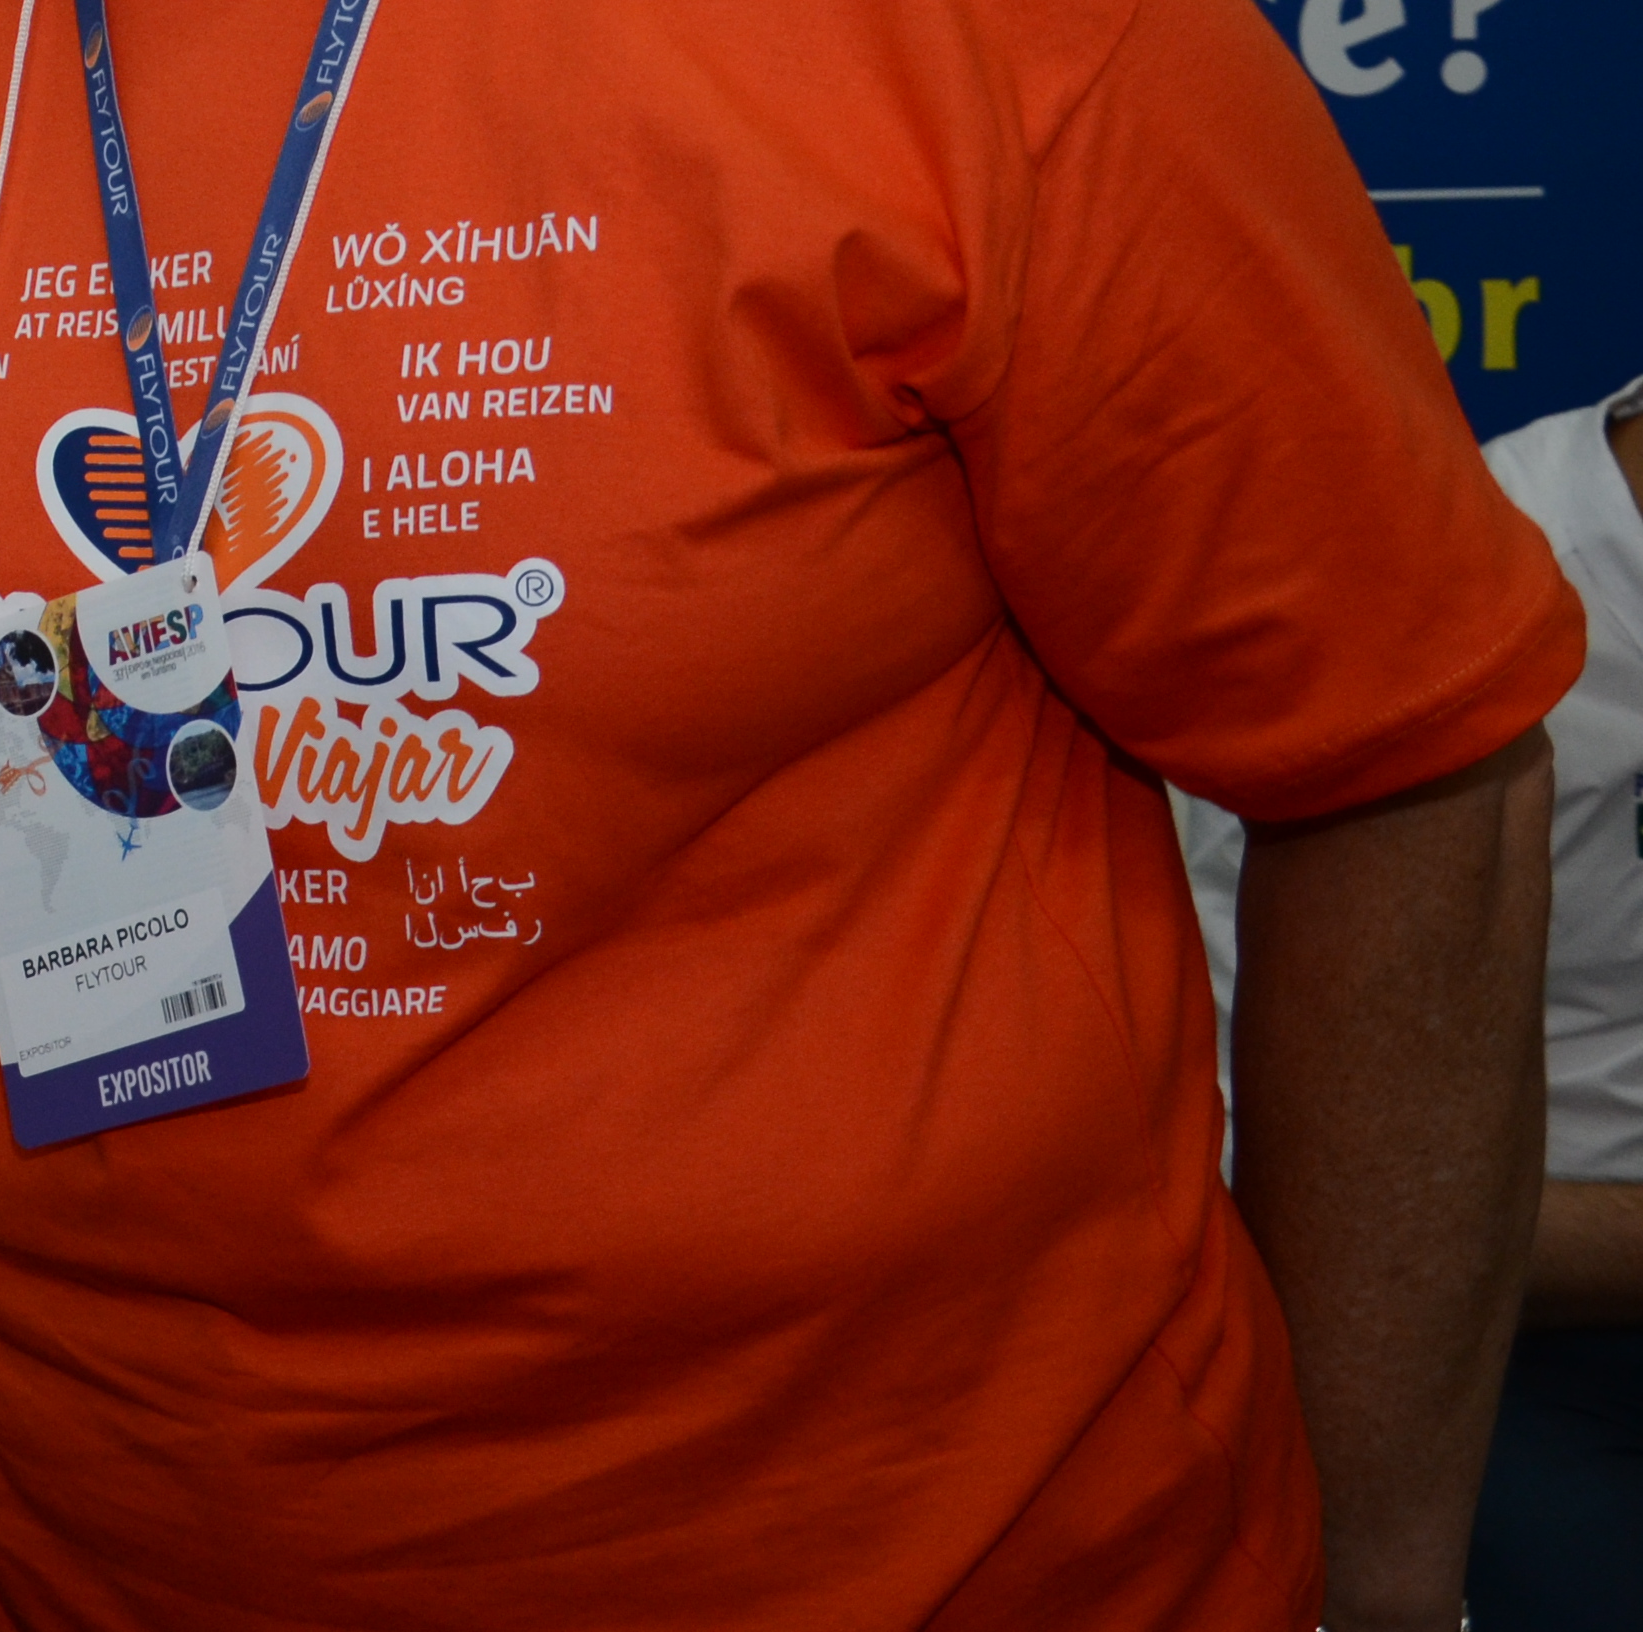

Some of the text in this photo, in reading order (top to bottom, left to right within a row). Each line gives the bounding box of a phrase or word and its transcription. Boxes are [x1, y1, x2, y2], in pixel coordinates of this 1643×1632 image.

[91, 69, 130, 217] FLYTOUR
[20, 250, 213, 302] JEG EKER
[14, 308, 119, 339] AT REJS
[220, 230, 283, 391] FLYTOUR
[401, 336, 551, 378] IK HOU
[397, 384, 613, 422] VAN REIZEN
[135, 352, 179, 505] FLYTOUR
[362, 447, 536, 493] I ALOHA
[362, 501, 481, 539] E HELE
[108, 603, 204, 666] AVIESP
[252, 697, 494, 841] Viajar
[279, 869, 348, 905] KER
[21, 908, 190, 979] BARBARA PICOLO
[75, 954, 148, 993] FLYTOUR
[19, 1035, 73, 1062] EXPOSITOR
[97, 1050, 213, 1108] EXPOSITOR
